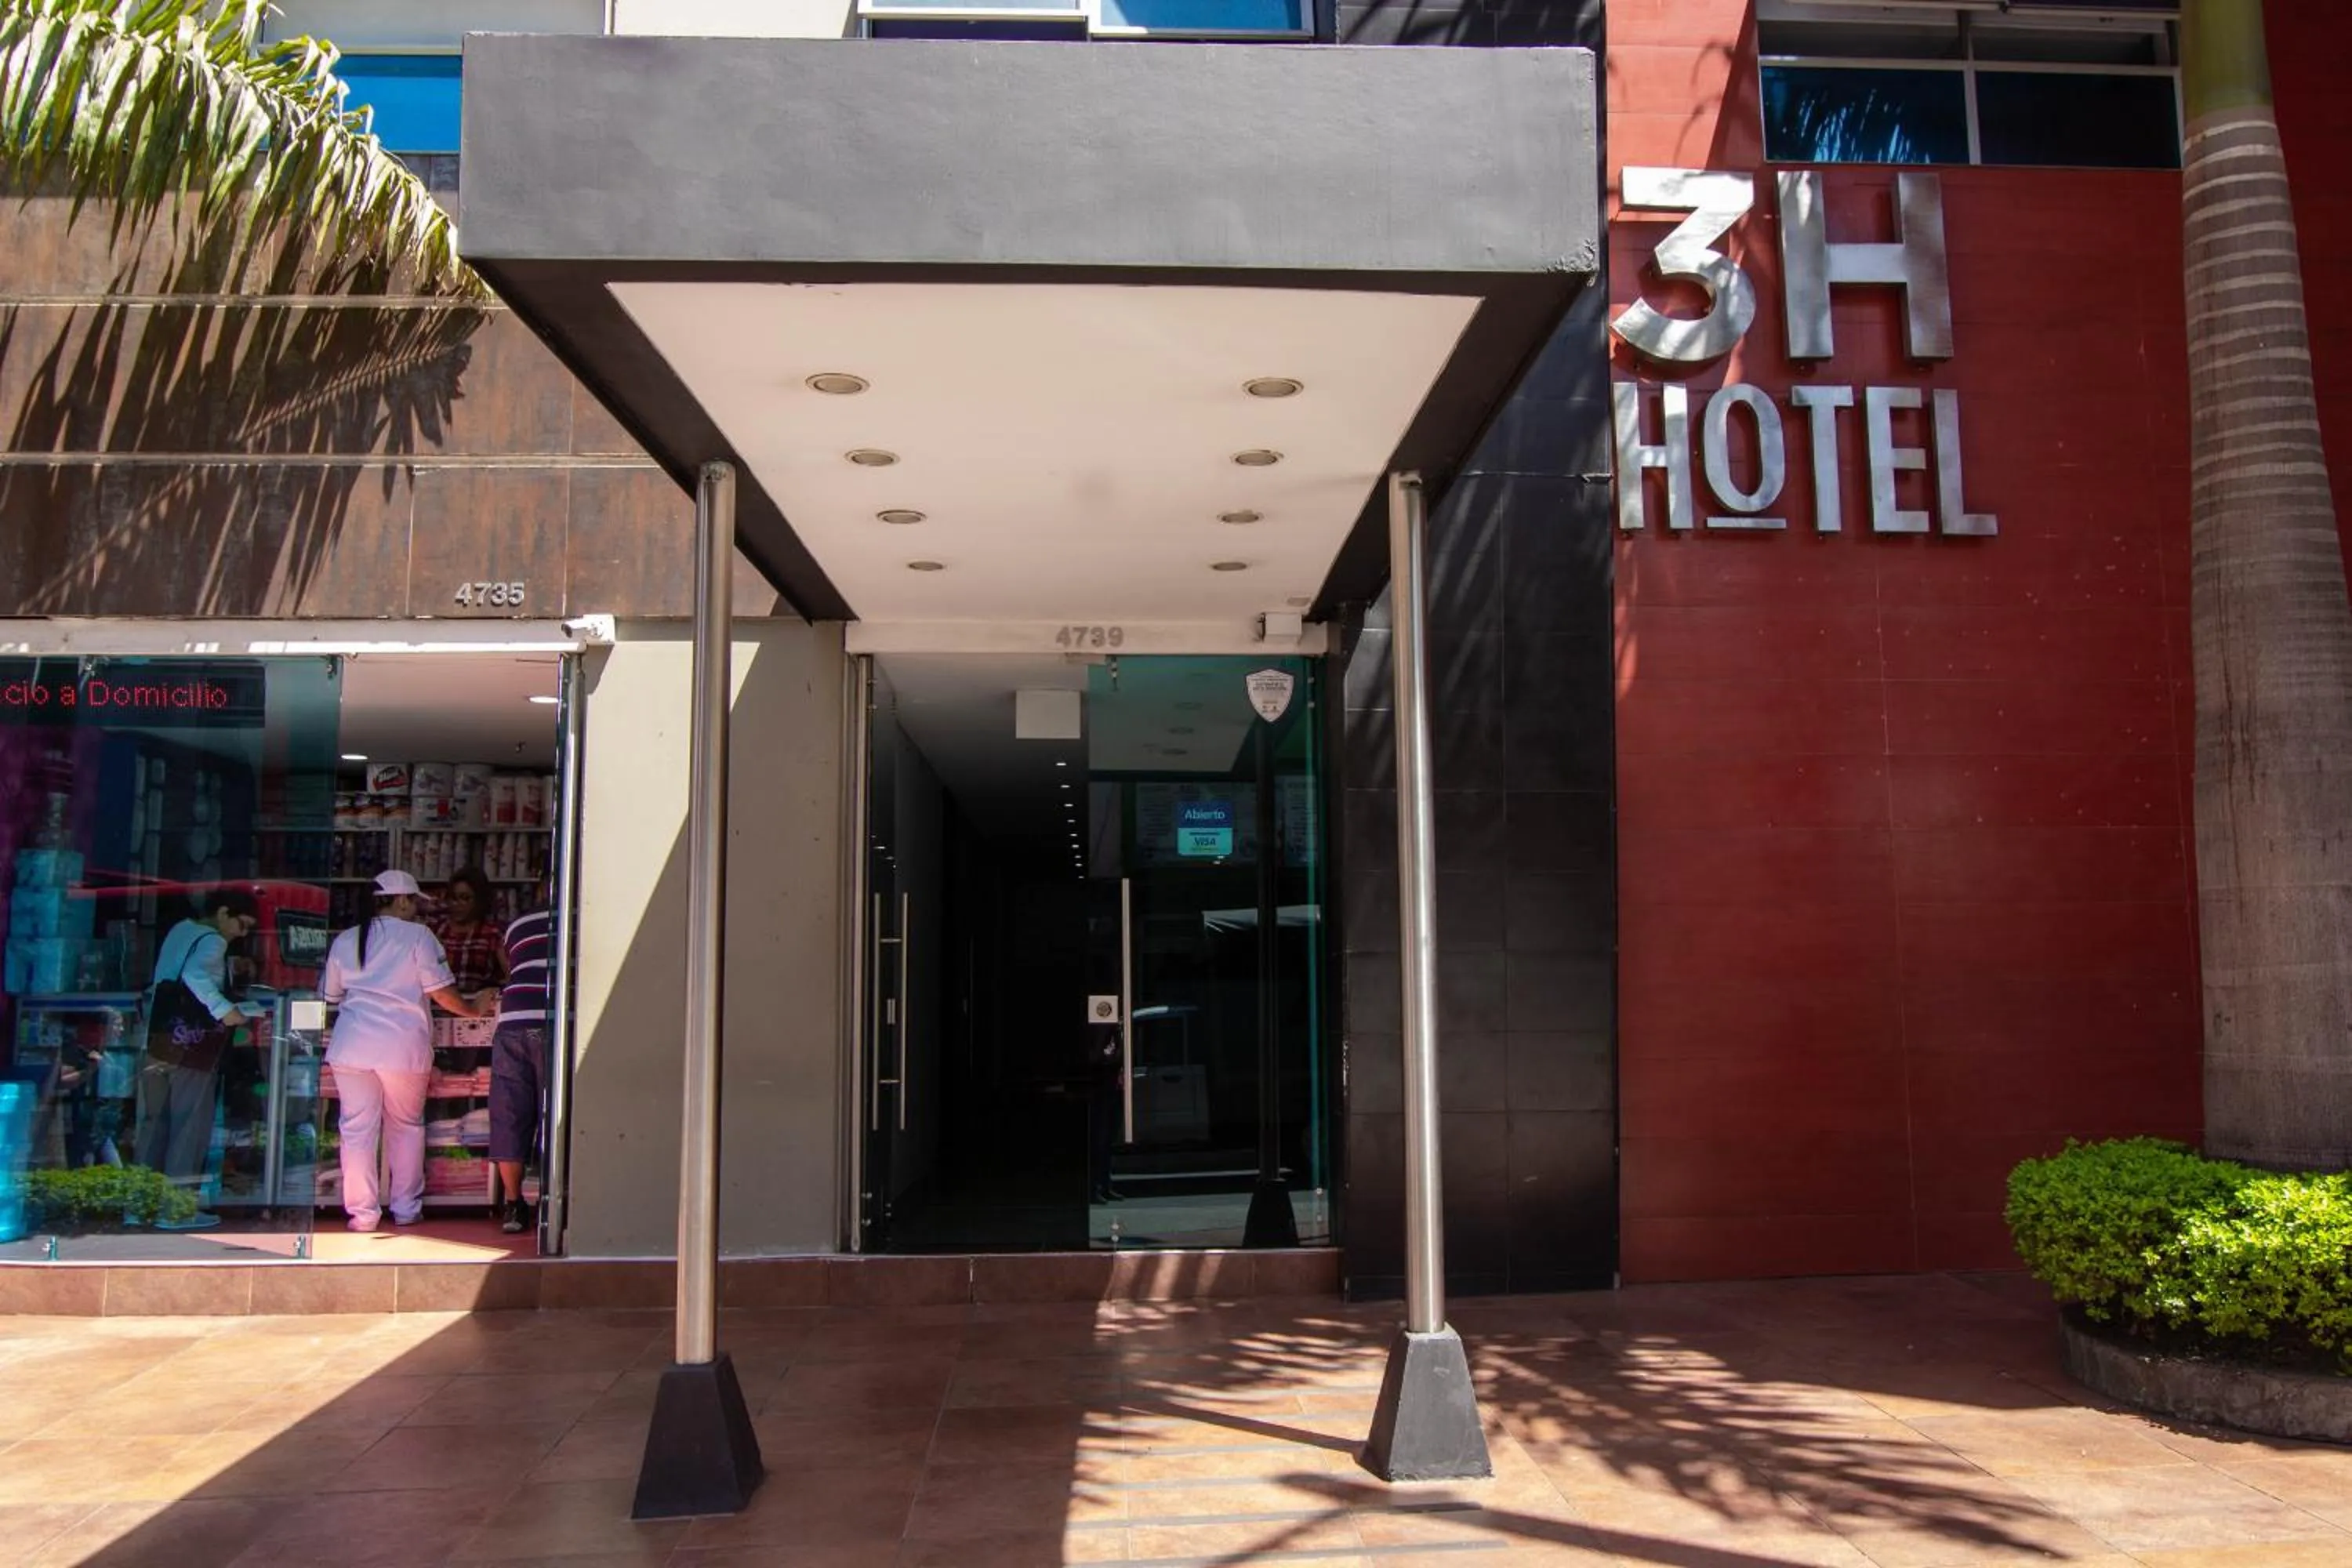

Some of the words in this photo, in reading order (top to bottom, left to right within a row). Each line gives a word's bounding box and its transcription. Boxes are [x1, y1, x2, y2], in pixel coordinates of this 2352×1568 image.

[1611, 165, 1954, 363] 3H
[1613, 382, 1998, 536] HOTEL
[455, 583, 524, 606] 4735
[1055, 626, 1124, 648] 4739
[60, 685, 76, 706] a
[88, 681, 227, 708] Domicilio
[1185, 808, 1225, 821] Abierto
[1193, 837, 1217, 846] VISA
